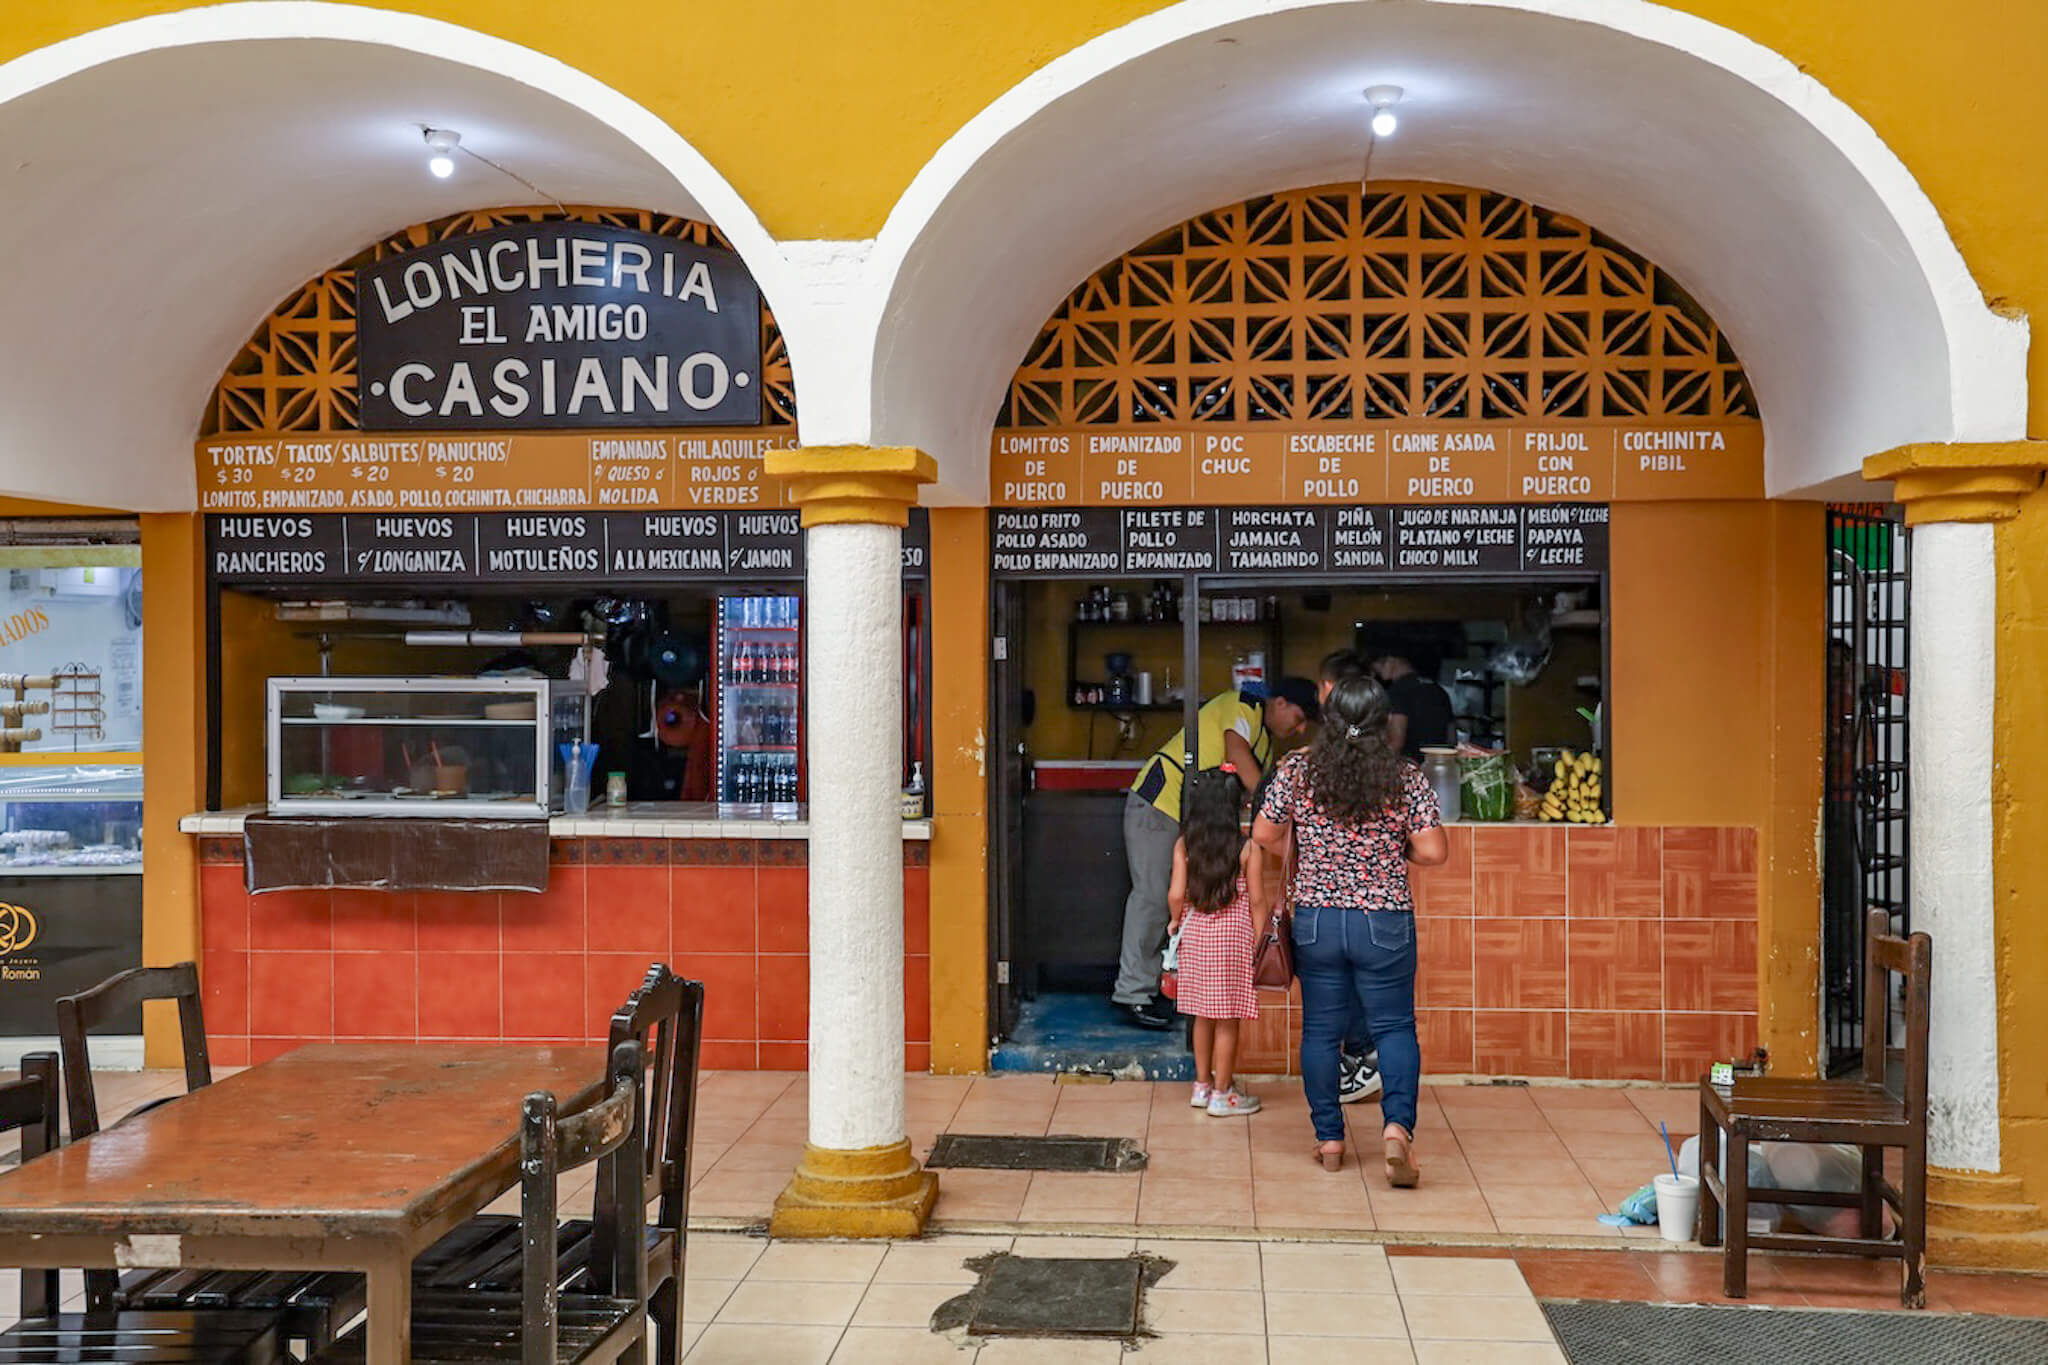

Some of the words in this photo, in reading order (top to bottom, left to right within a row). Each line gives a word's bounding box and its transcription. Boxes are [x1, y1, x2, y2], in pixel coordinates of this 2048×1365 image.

[373, 237, 719, 324] LONCHERIA
[459, 304, 507, 345] EL
[525, 303, 648, 343] AMIGO
[388, 351, 730, 418] CASIANO
[679, 439, 774, 459] CHILAQUILES
[1000, 436, 1070, 454] LOMITOS
[1089, 436, 1182, 454] EMPANIZADO
[1206, 435, 1245, 454] POC
[1290, 435, 1376, 453] ESCABECHE
[1392, 434, 1439, 452] CARNE
[1444, 434, 1496, 452] ASADA
[1525, 432, 1590, 452] FRIJOL
[1623, 431, 1726, 451] COCHINITA
[592, 440, 668, 461] EMPANADAS
[1025, 460, 1046, 477] DE
[1117, 459, 1138, 476] DE
[1201, 457, 1251, 475] CHUC
[1319, 457, 1342, 474] DE
[1429, 457, 1451, 473] DE
[1538, 456, 1574, 472] CON
[1640, 455, 1687, 471] PIBIL
[607, 466, 650, 482] QUESO
[691, 466, 741, 482] ROJOS
[688, 486, 759, 504] VERDES
[1004, 481, 1066, 501] PUERCO
[1100, 481, 1163, 500] PUERCO
[1303, 479, 1360, 498] POLLO
[1408, 478, 1474, 497] PUERCO
[1523, 476, 1591, 496] PUERCO
[599, 487, 660, 505] MOLIDA
[998, 514, 1038, 530] POLLO
[1041, 513, 1081, 529] FRITO
[1126, 511, 1182, 528] FILETE
[1187, 510, 1206, 527] DE
[1232, 511, 1316, 526] HORCHATA
[1337, 508, 1375, 527] PIÑA
[1398, 509, 1433, 527] JUGO
[1433, 509, 1450, 525] DE
[1451, 508, 1518, 525] NARANJA
[1528, 504, 1570, 524] MELÓN
[220, 518, 313, 538] HUEVOS
[376, 518, 453, 538] HUEVOS
[507, 517, 586, 537] HUEVOS
[645, 515, 718, 537] HUEVOS
[738, 515, 799, 535] HUEVOS
[996, 534, 1037, 549] POLLO
[1040, 533, 1088, 549] ASADO
[1129, 531, 1177, 548] POLLO
[1229, 531, 1302, 547] JAMAICA
[1334, 527, 1383, 546] MELÓN
[1399, 529, 1461, 546] PLATANO
[1527, 527, 1584, 545] PAPAYA
[216, 551, 326, 573] RANCHEROS
[489, 545, 599, 571] MOTULEÑOS
[614, 549, 625, 571] A
[627, 549, 645, 570] LA
[648, 549, 723, 570] MEXICANA
[994, 553, 1032, 570] POLLO
[1034, 552, 1119, 570] EMPANIZADO
[1126, 552, 1213, 570] EMPANIZADO
[1229, 551, 1320, 569] TAMARINDO
[1333, 551, 1385, 567] SANDIA
[1399, 549, 1439, 566] CHOCO
[1442, 548, 1479, 566] MILK
[2, 965, 42, 981] Román
